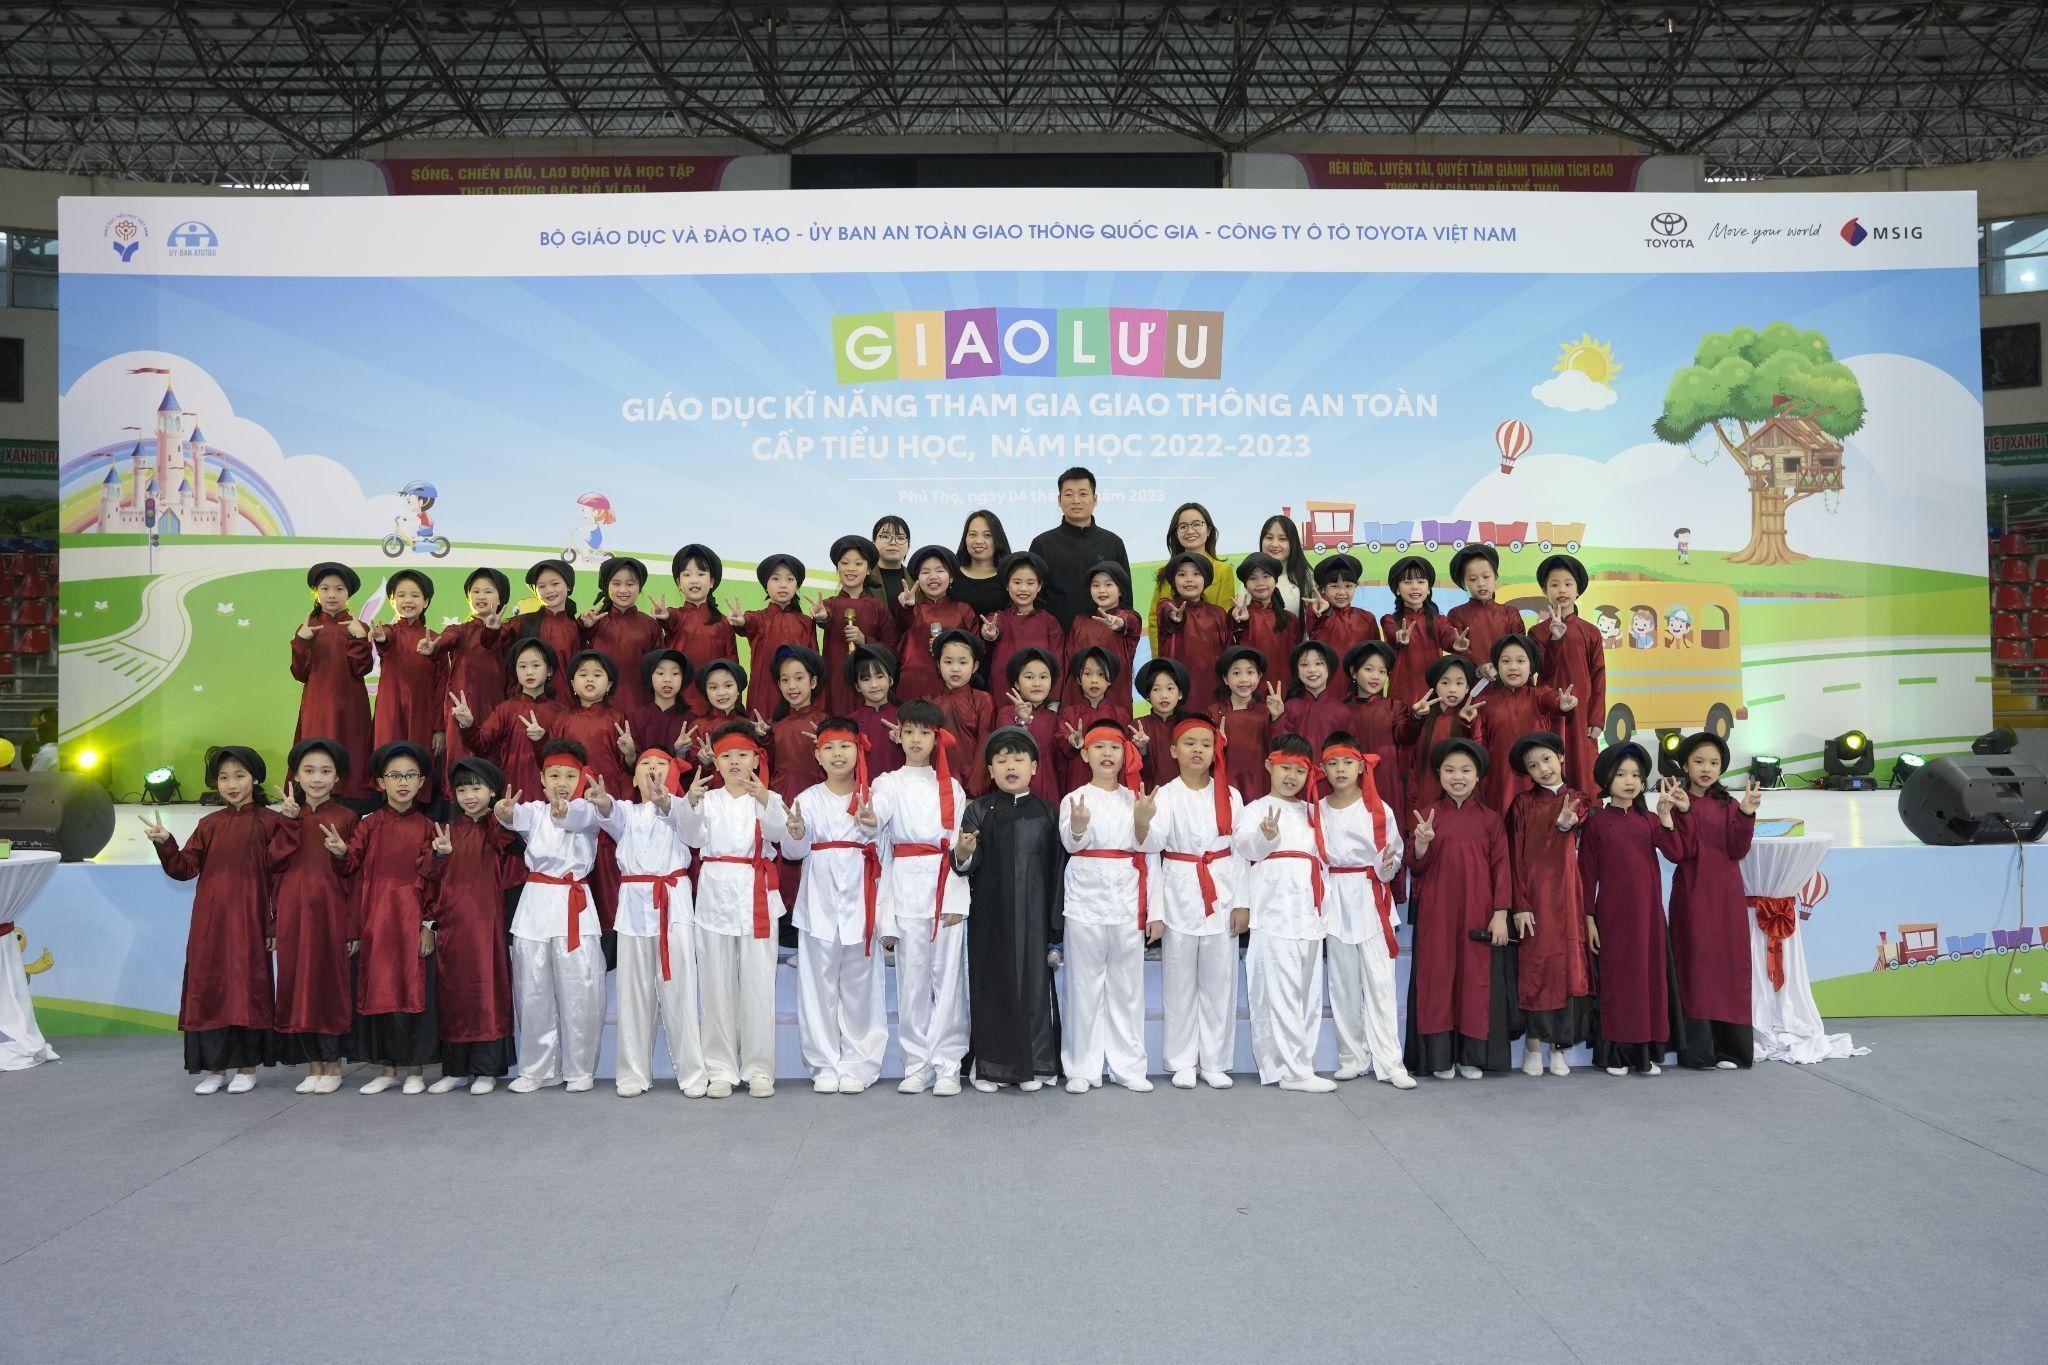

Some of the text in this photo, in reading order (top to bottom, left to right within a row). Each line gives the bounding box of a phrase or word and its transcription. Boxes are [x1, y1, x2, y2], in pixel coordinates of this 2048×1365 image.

[458, 163, 500, 180] CHIẾN
[541, 165, 567, 179] LAO
[571, 163, 610, 181] ĐỘNG
[614, 163, 632, 178] VÀ
[636, 165, 664, 180] HỌC
[668, 163, 696, 180] TẬP
[1380, 159, 1412, 178] LUYỆN
[1437, 158, 1469, 177] QUYẾT
[1471, 160, 1494, 176] TÂM
[1496, 160, 1528, 177] GIÀNH
[1531, 160, 1564, 177] THÀNH
[1567, 160, 1590, 177] TÍCH
[1593, 163, 1614, 177] CAO
[540, 228, 565, 248] BỘ
[571, 226, 621, 246] GIÁO
[627, 229, 666, 248] DỤC
[672, 225, 698, 244] VÀ
[704, 225, 747, 243] ĐÀO
[753, 226, 790, 245] TẠO
[809, 221, 832, 241] ỦY
[838, 225, 876, 241] BAN
[882, 225, 909, 240] AN
[915, 221, 967, 240] TOÀN
[973, 224, 1022, 240] GIAO
[1029, 221, 1095, 240] THÔNG
[1100, 219, 1158, 240] QUỐC
[1164, 224, 1199, 240] GIA
[1217, 222, 1277, 240] CÔNG
[1282, 225, 1301, 240] TY
[1307, 222, 1322, 240] Ô
[1327, 223, 1350, 240] TÔ
[1356, 225, 1428, 241] TOYOTA
[1432, 223, 1468, 244] VIỆT
[1474, 227, 1516, 242] NAM
[1708, 222, 1823, 244] Move your world
[1873, 226, 1923, 240] MSIG
[1645, 238, 1695, 249] TOYOTA
[621, 387, 1438, 428] GIÁO DỤC KĨ NĂNG THAM GIA GIAO THÔNG AN TOÀN
[752, 425, 1312, 466] CẤP TIỂU HỌC, NĂM HỌC 2022-2023
[900, 489, 927, 503] Phú
[932, 489, 963, 507] Thọ,
[969, 488, 1004, 508] ngày
[1008, 489, 1027, 502] 04
[1031, 489, 1059, 502] thá
[1129, 489, 1166, 503] 2023
